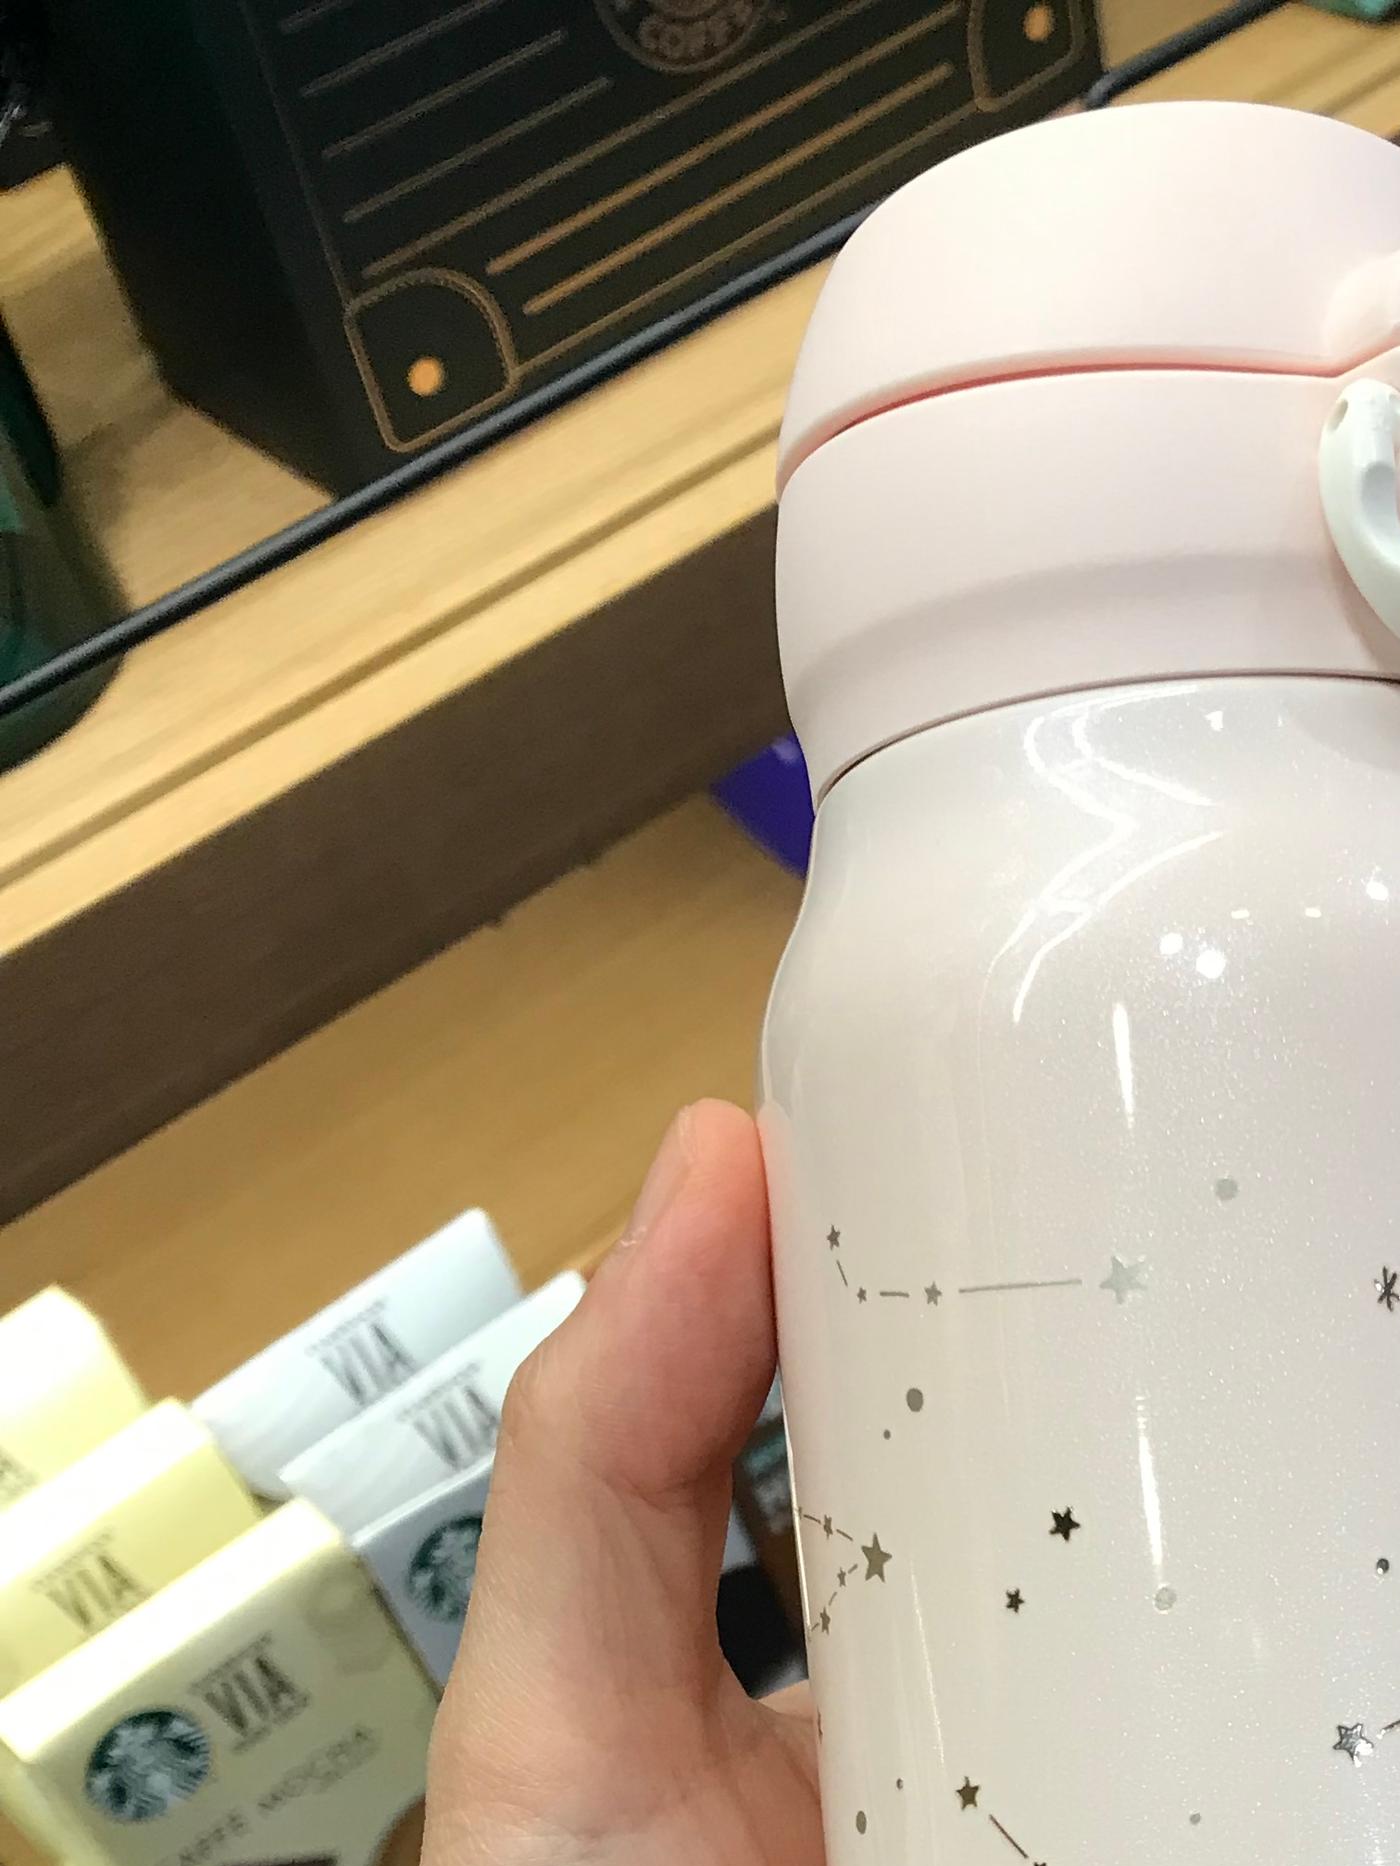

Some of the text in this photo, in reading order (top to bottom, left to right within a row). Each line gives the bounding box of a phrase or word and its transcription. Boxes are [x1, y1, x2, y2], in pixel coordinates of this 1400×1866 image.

[319, 1322, 418, 1406] VIA
[46, 1553, 152, 1635] VIA
[203, 1654, 308, 1740] VIA
